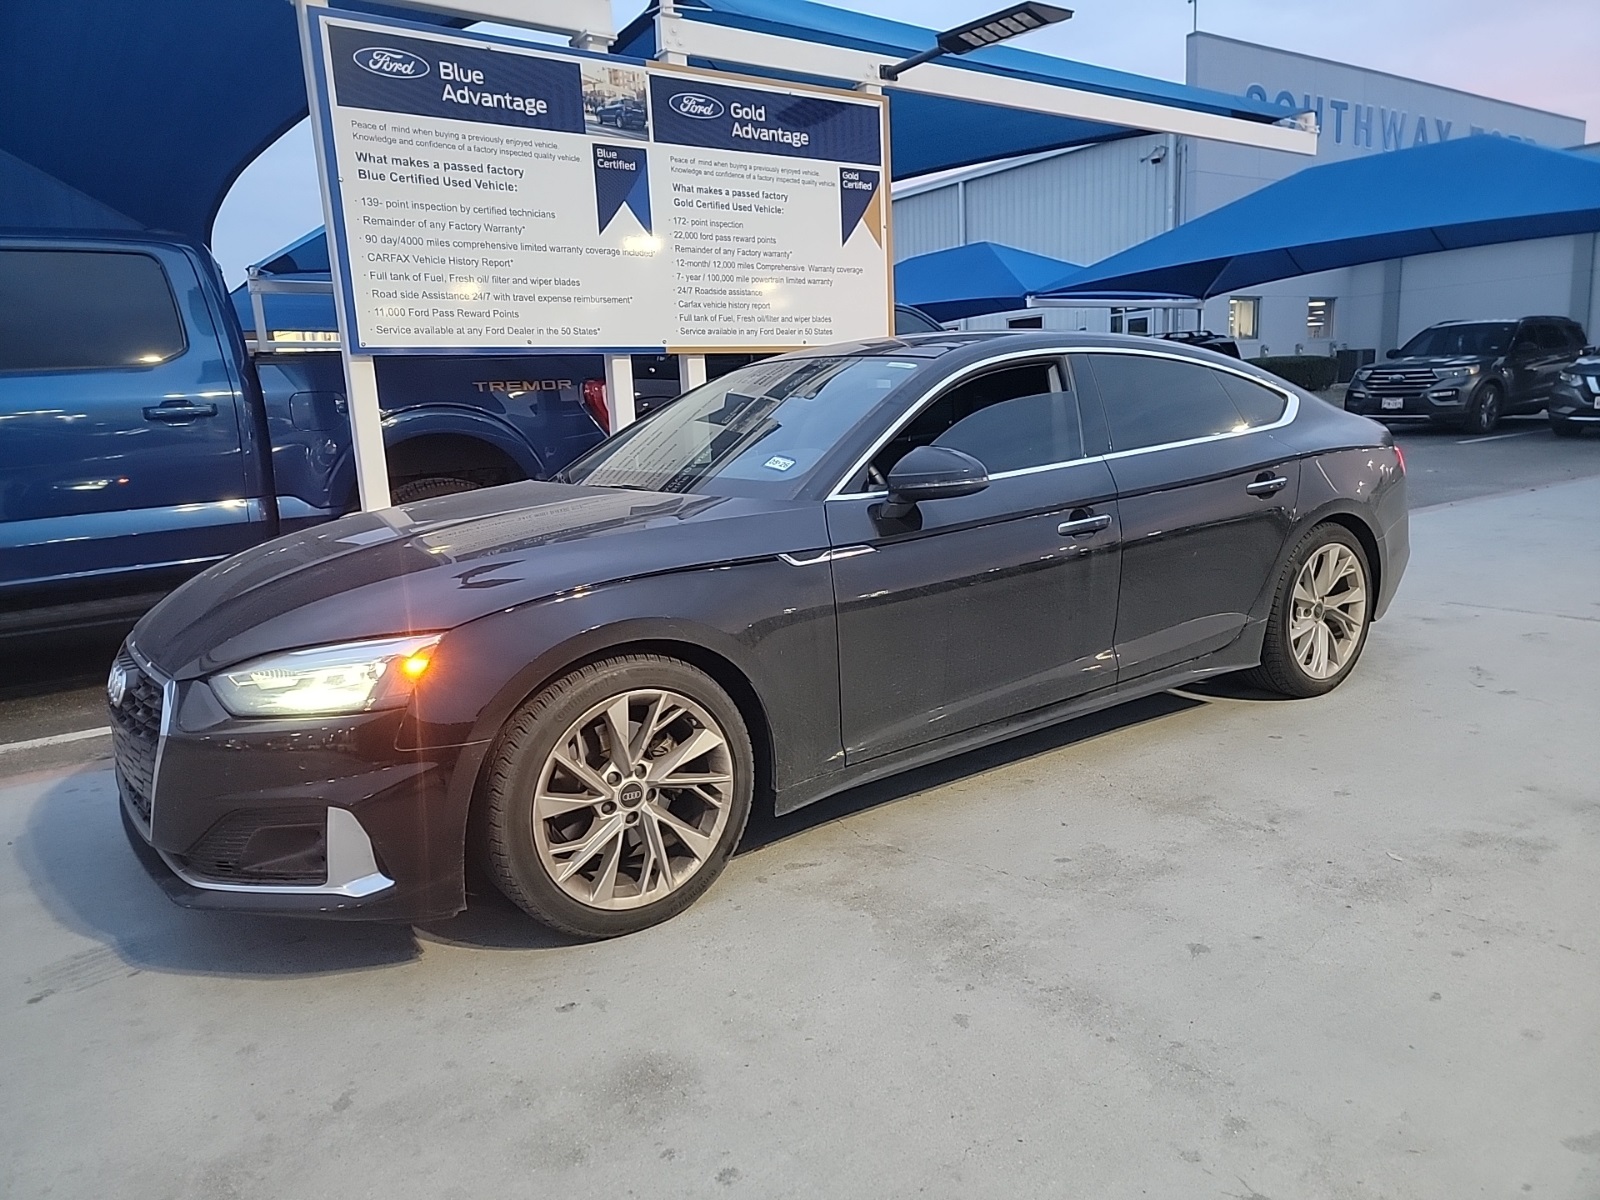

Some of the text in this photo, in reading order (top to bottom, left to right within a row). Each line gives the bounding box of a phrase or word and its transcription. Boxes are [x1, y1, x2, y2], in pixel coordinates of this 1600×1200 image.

[368, 50, 415, 75] Ford
[438, 62, 484, 84] Blue
[442, 84, 548, 116] Advantage
[679, 95, 714, 116] Ford
[730, 102, 766, 122] Gold
[351, 120, 377, 131] Peace
[377, 123, 386, 131] of
[391, 125, 410, 133] mind
[411, 128, 432, 136] when
[434, 129, 459, 140] buying
[467, 132, 503, 144] previously
[505, 138, 532, 147] enjoyed
[732, 122, 809, 148] Advantage
[352, 133, 396, 144] Knowledge
[415, 140, 455, 149] confidence
[457, 142, 464, 150] of
[473, 144, 497, 155] factory
[499, 147, 532, 157] inspected
[534, 152, 555, 160] quality
[596, 148, 618, 160] Blue
[355, 151, 387, 163] What
[391, 157, 428, 167] makes
[443, 162, 483, 172] passed
[487, 164, 523, 177] factory
[597, 158, 636, 171] Certified
[358, 169, 516, 191] Blue Certified Used Vehicle:
[842, 171, 859, 181] Gold
[842, 180, 872, 191] Certified
[672, 183, 787, 202] What makes a passed factory
[385, 200, 409, 210] point
[411, 201, 457, 213] inspection
[458, 204, 470, 214] by
[471, 206, 507, 215] certified
[509, 208, 554, 218] technicians
[673, 198, 783, 213] Gold Certified Used Vehicle:
[363, 215, 414, 227] Remainder
[417, 219, 426, 229] of
[429, 221, 445, 231] any
[448, 220, 481, 232] Factory
[690, 218, 708, 227] point
[709, 219, 743, 228] inspection
[674, 231, 698, 240] 22,000
[699, 232, 713, 241] ford
[715, 234, 731, 242] pass
[365, 234, 619, 256] 90 day/4000 miles comprehensive limited warranty coverage
[674, 245, 712, 253] Remainder
[714, 247, 721, 255] of
[722, 248, 735, 256] any
[736, 248, 761, 257] Factory
[367, 253, 409, 263] CARFAX
[412, 254, 445, 264] Vehicle
[448, 256, 479, 267] History
[712, 261, 735, 269] 12,000
[755, 262, 804, 271] Comprehensive
[369, 271, 387, 281] Full
[390, 272, 410, 283] tank
[411, 273, 421, 283] of
[423, 273, 447, 283] Fuel,
[449, 273, 475, 282] Fresh
[491, 275, 509, 284] filter
[512, 277, 527, 286] and
[529, 277, 551, 286] wiper
[554, 277, 579, 286] blades
[684, 273, 701, 282] year
[707, 274, 734, 283] 100,000
[735, 275, 749, 283] mile
[372, 289, 398, 300] Road
[398, 290, 420, 301] side
[420, 291, 469, 301] Assistance
[472, 292, 491, 302] 24/7
[491, 292, 510, 302] with
[512, 292, 535, 301] travel
[537, 293, 571, 302] expense
[677, 287, 693, 295] 24/7
[694, 287, 726, 295] Roadside
[678, 300, 701, 309] Carfax
[702, 301, 726, 309] vehicle
[728, 301, 749, 309] history
[408, 308, 429, 318] Ford
[432, 308, 454, 318] Pass
[457, 308, 490, 318] Reward
[492, 308, 518, 319] Points
[679, 314, 692, 323] Full
[693, 314, 709, 323] tank
[709, 314, 717, 323] of
[718, 314, 734, 323] Fuel,
[736, 314, 755, 322] Fresh
[780, 315, 792, 323] and
[376, 325, 411, 337] Service
[412, 325, 453, 336] available
[456, 326, 465, 337] at
[465, 326, 483, 337] any
[483, 326, 505, 337] Ford
[505, 326, 534, 337] Dealer
[546, 327, 559, 336] the
[561, 327, 571, 337] 50
[680, 327, 705, 336] Service
[707, 327, 736, 336] available
[738, 327, 744, 335] in
[759, 327, 774, 336] Ford
[775, 327, 796, 335] Dealer
[797, 327, 803, 335] in
[804, 327, 812, 335] 50
[472, 379, 572, 392] TREMOR
